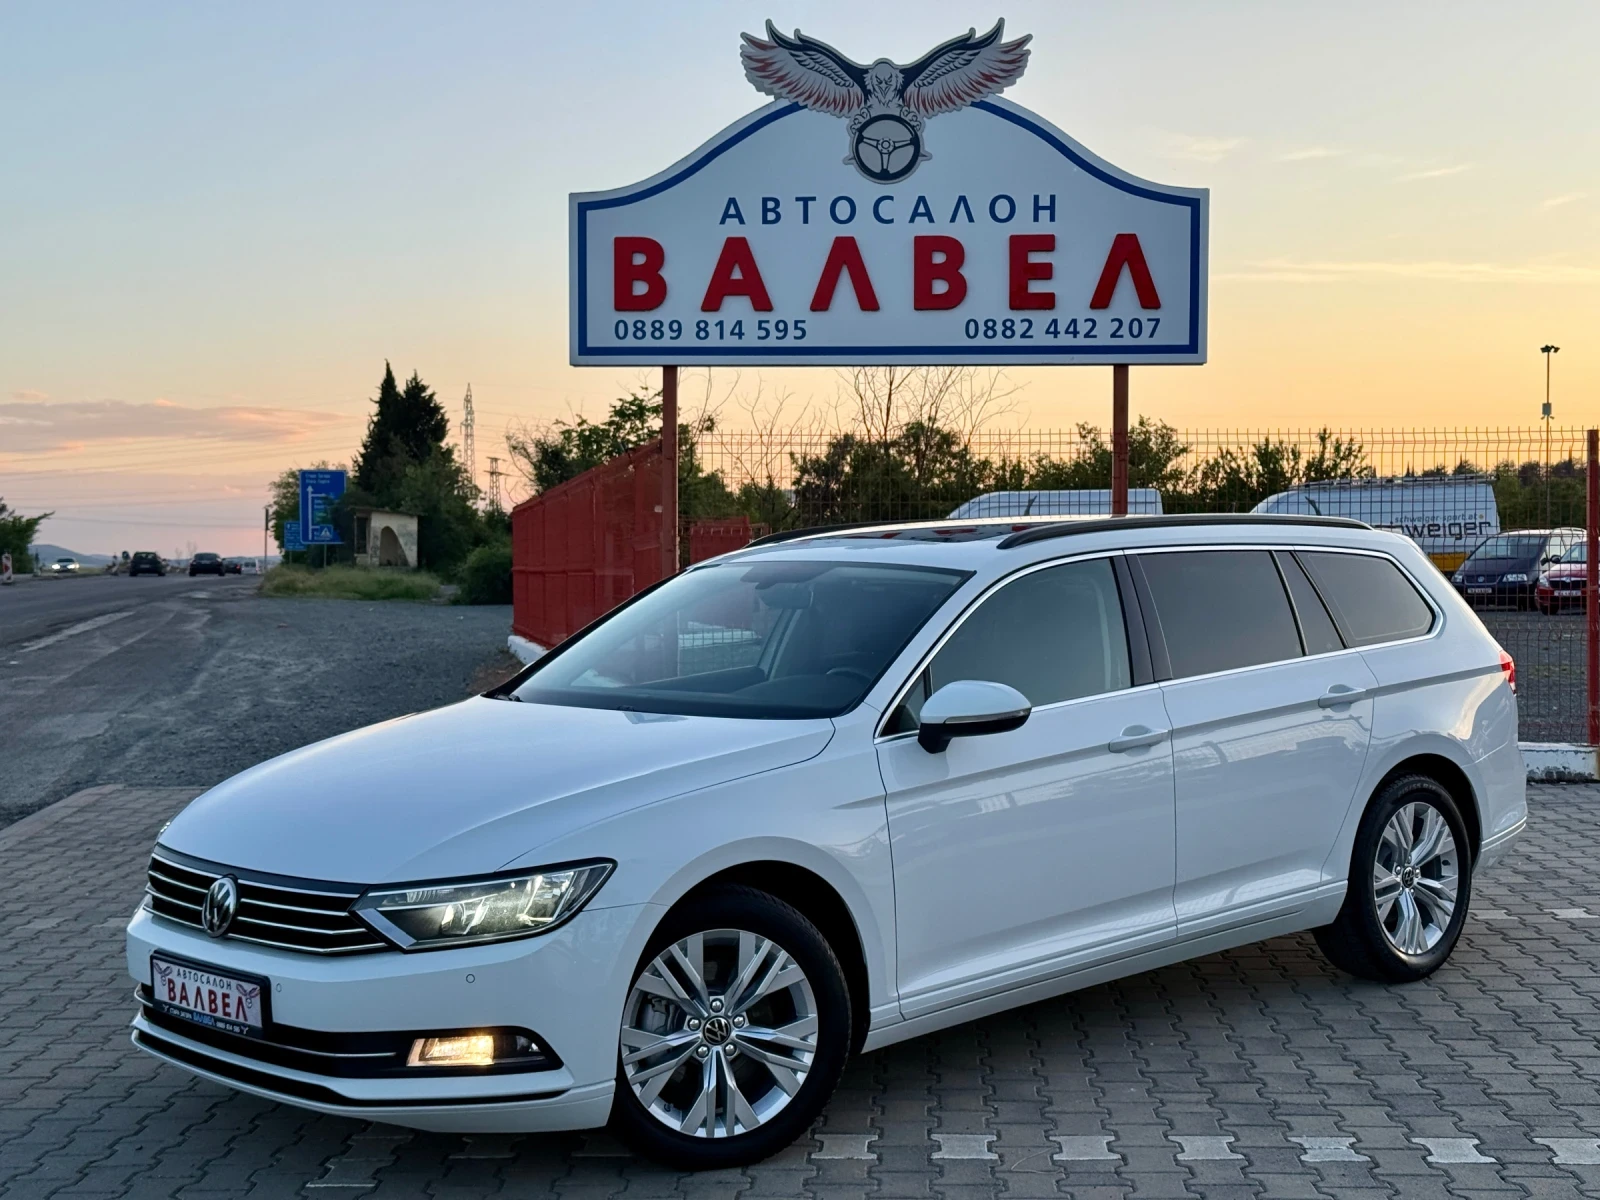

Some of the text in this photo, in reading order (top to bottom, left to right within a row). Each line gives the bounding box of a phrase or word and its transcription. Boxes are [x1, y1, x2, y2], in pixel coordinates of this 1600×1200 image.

[719, 194, 1056, 225] АВТОСАЛОН
[613, 233, 1162, 313] ВАЛВЕЛ
[614, 319, 807, 341] 0889 814 595
[965, 317, 1161, 339] 0882 442 207
[176, 968, 232, 991] АВТОСАЛОН
[167, 977, 248, 1022] ВАЛВЕЛ
